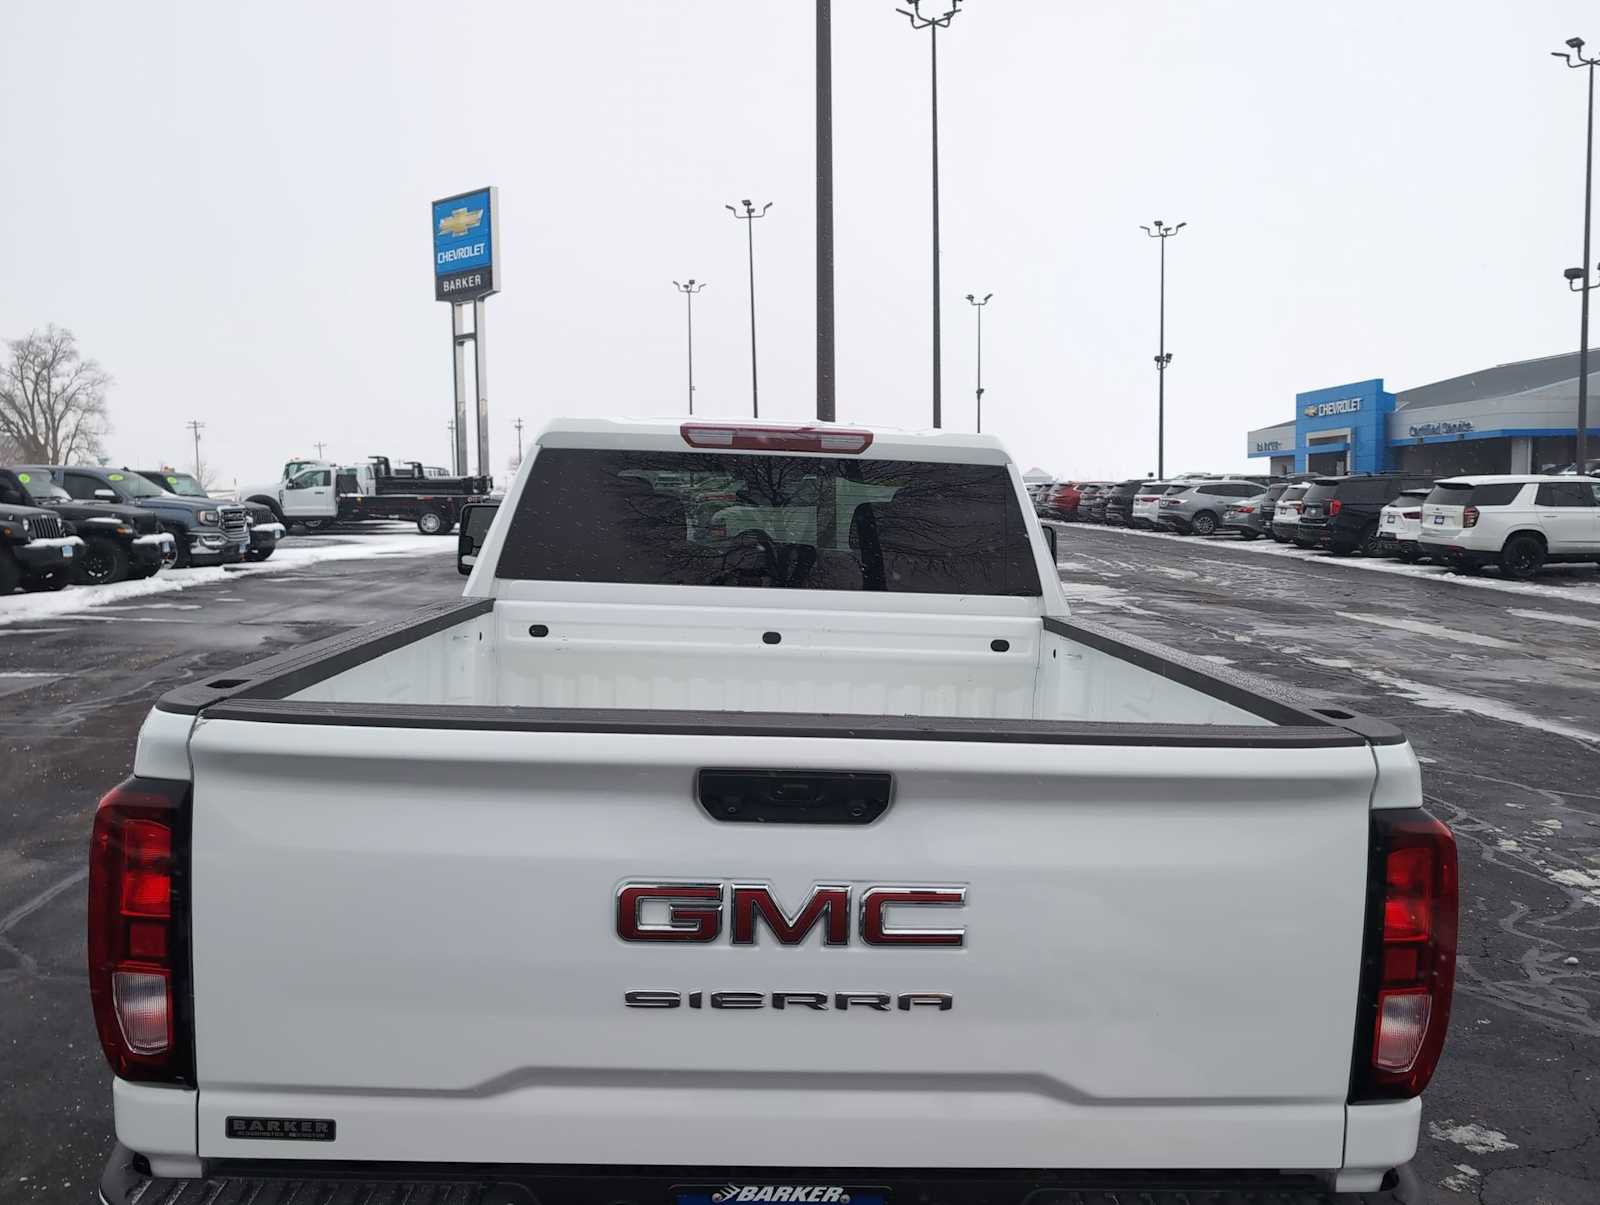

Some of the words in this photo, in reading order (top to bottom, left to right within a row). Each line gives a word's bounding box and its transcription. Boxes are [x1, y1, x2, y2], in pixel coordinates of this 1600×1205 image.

[437, 243, 485, 264] CHEVROLET
[443, 274, 481, 292] BARKER
[1318, 397, 1362, 417] CHEVROLET
[615, 879, 967, 948] GMC
[624, 989, 953, 1012] SIERRA
[232, 1119, 329, 1132] BARKER
[735, 1185, 844, 1202] BARKER
